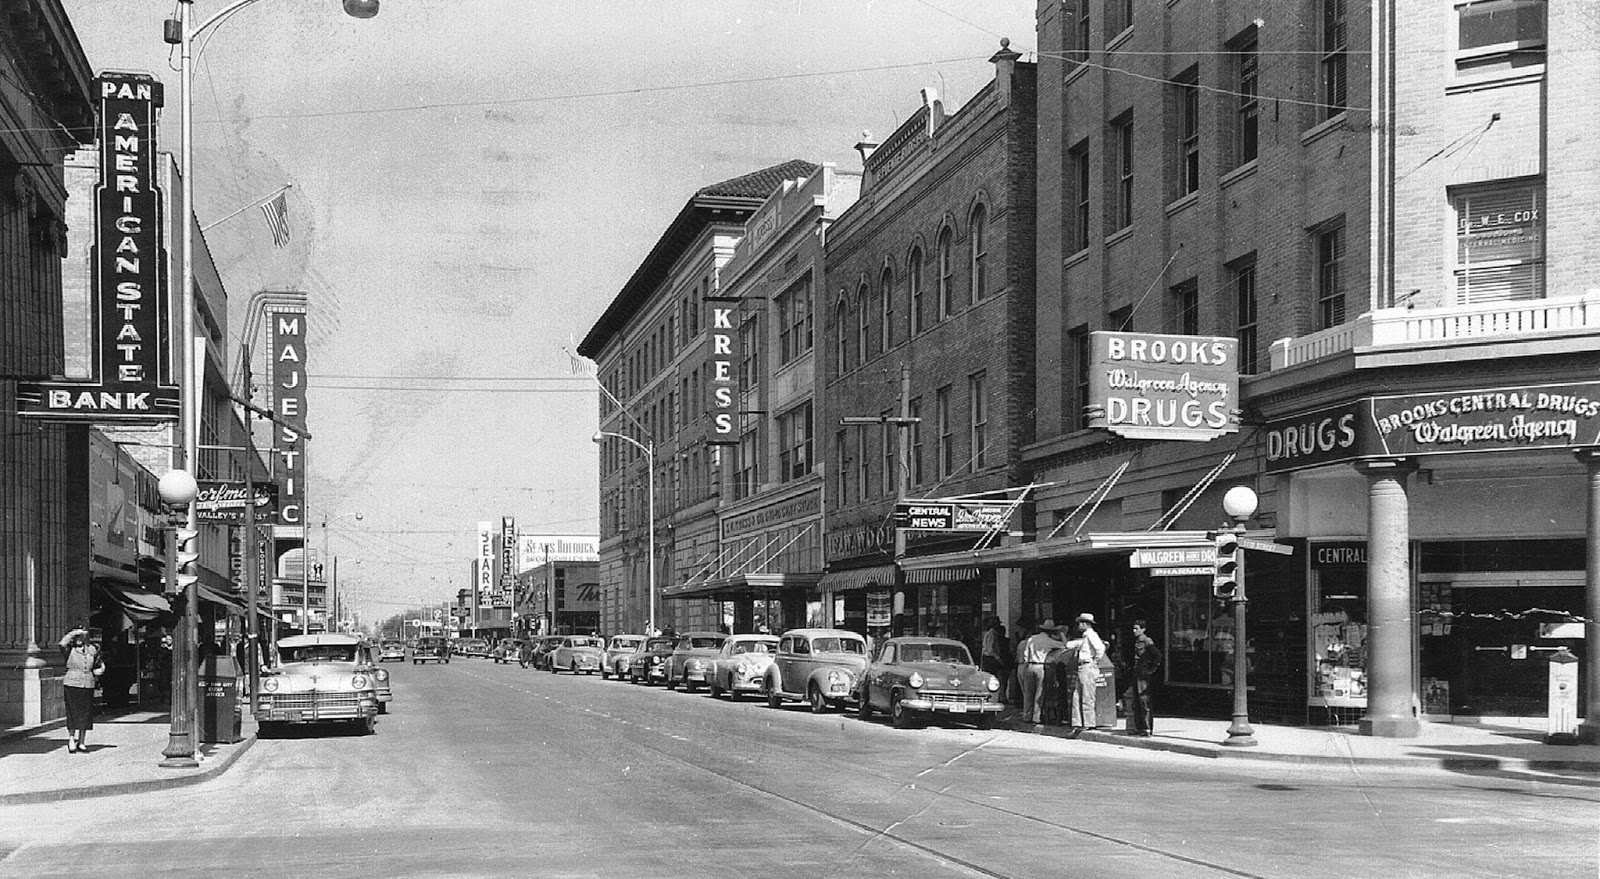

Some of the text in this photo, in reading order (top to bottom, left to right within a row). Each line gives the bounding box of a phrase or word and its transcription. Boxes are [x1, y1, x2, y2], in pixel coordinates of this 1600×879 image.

[102, 82, 151, 100] PAN
[113, 112, 142, 275] AMERICAN
[1514, 209, 1539, 223] COX
[115, 282, 145, 382] STATE
[713, 308, 732, 434] KRESS
[1106, 368, 1230, 400] Walgreen Agency
[48, 389, 151, 410] BANK
[1107, 397, 1228, 428] DRUGS
[1378, 392, 1600, 435] BROOKS CENTRAL DRUGS
[278, 317, 300, 524] MAJESTIC
[1409, 414, 1578, 445] Walgreen Agency
[1266, 413, 1355, 462] DRUGS
[908, 506, 951, 516] CENTRAL
[910, 518, 947, 528] NEWS
[1140, 551, 1185, 564] WALGREEN
[1154, 566, 1217, 576] PHARMACY
[1318, 548, 1368, 563] CENTRAL
